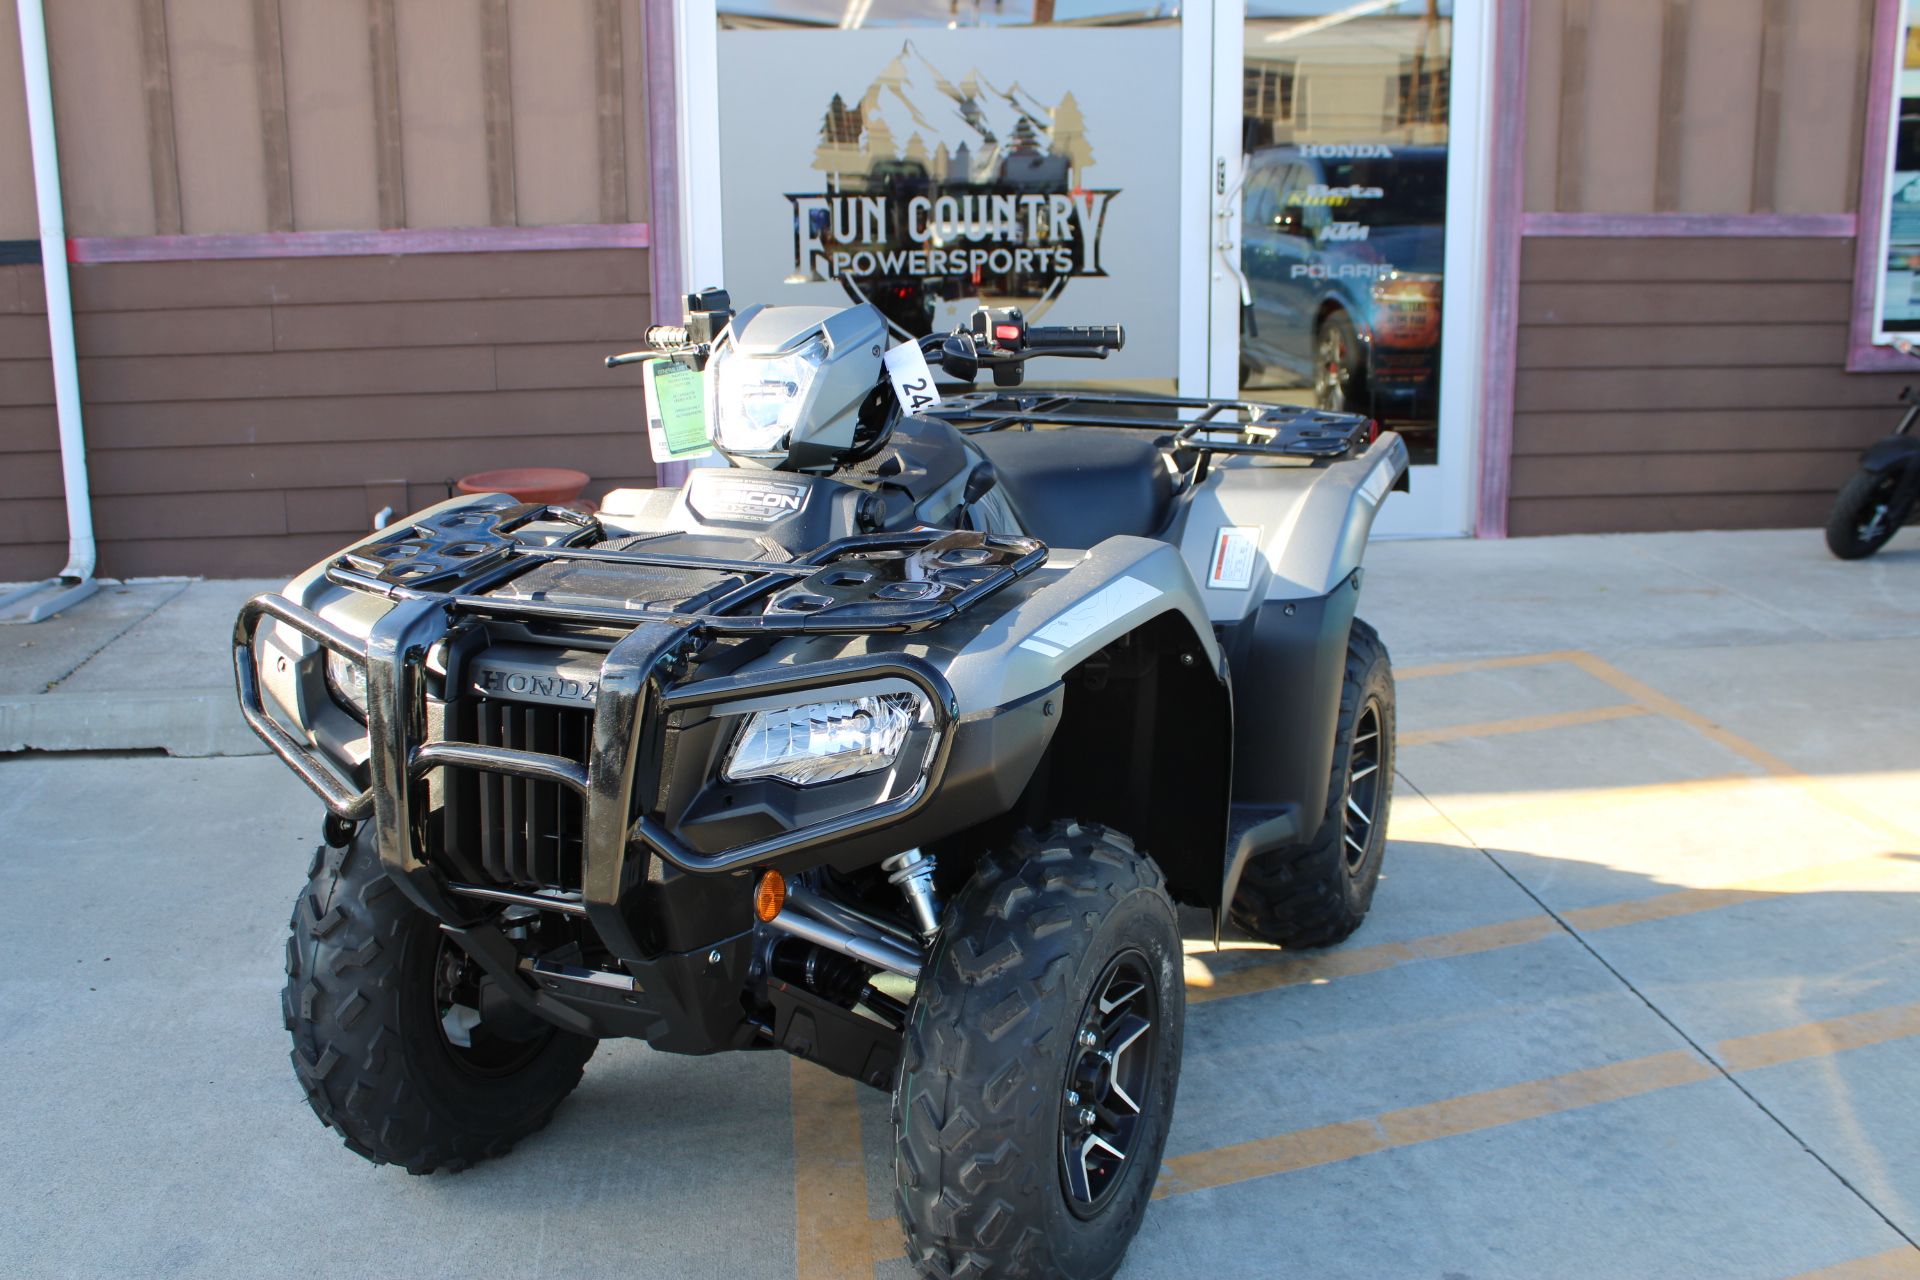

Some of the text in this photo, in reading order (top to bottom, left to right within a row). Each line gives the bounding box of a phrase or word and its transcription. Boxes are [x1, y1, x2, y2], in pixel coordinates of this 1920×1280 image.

[1300, 144, 1393, 158] HONDA
[788, 194, 1104, 281] FUN COUNTRY
[1319, 222, 1370, 241] KTM
[833, 248, 1073, 275] POWERSPORTS
[902, 377, 934, 415] 24
